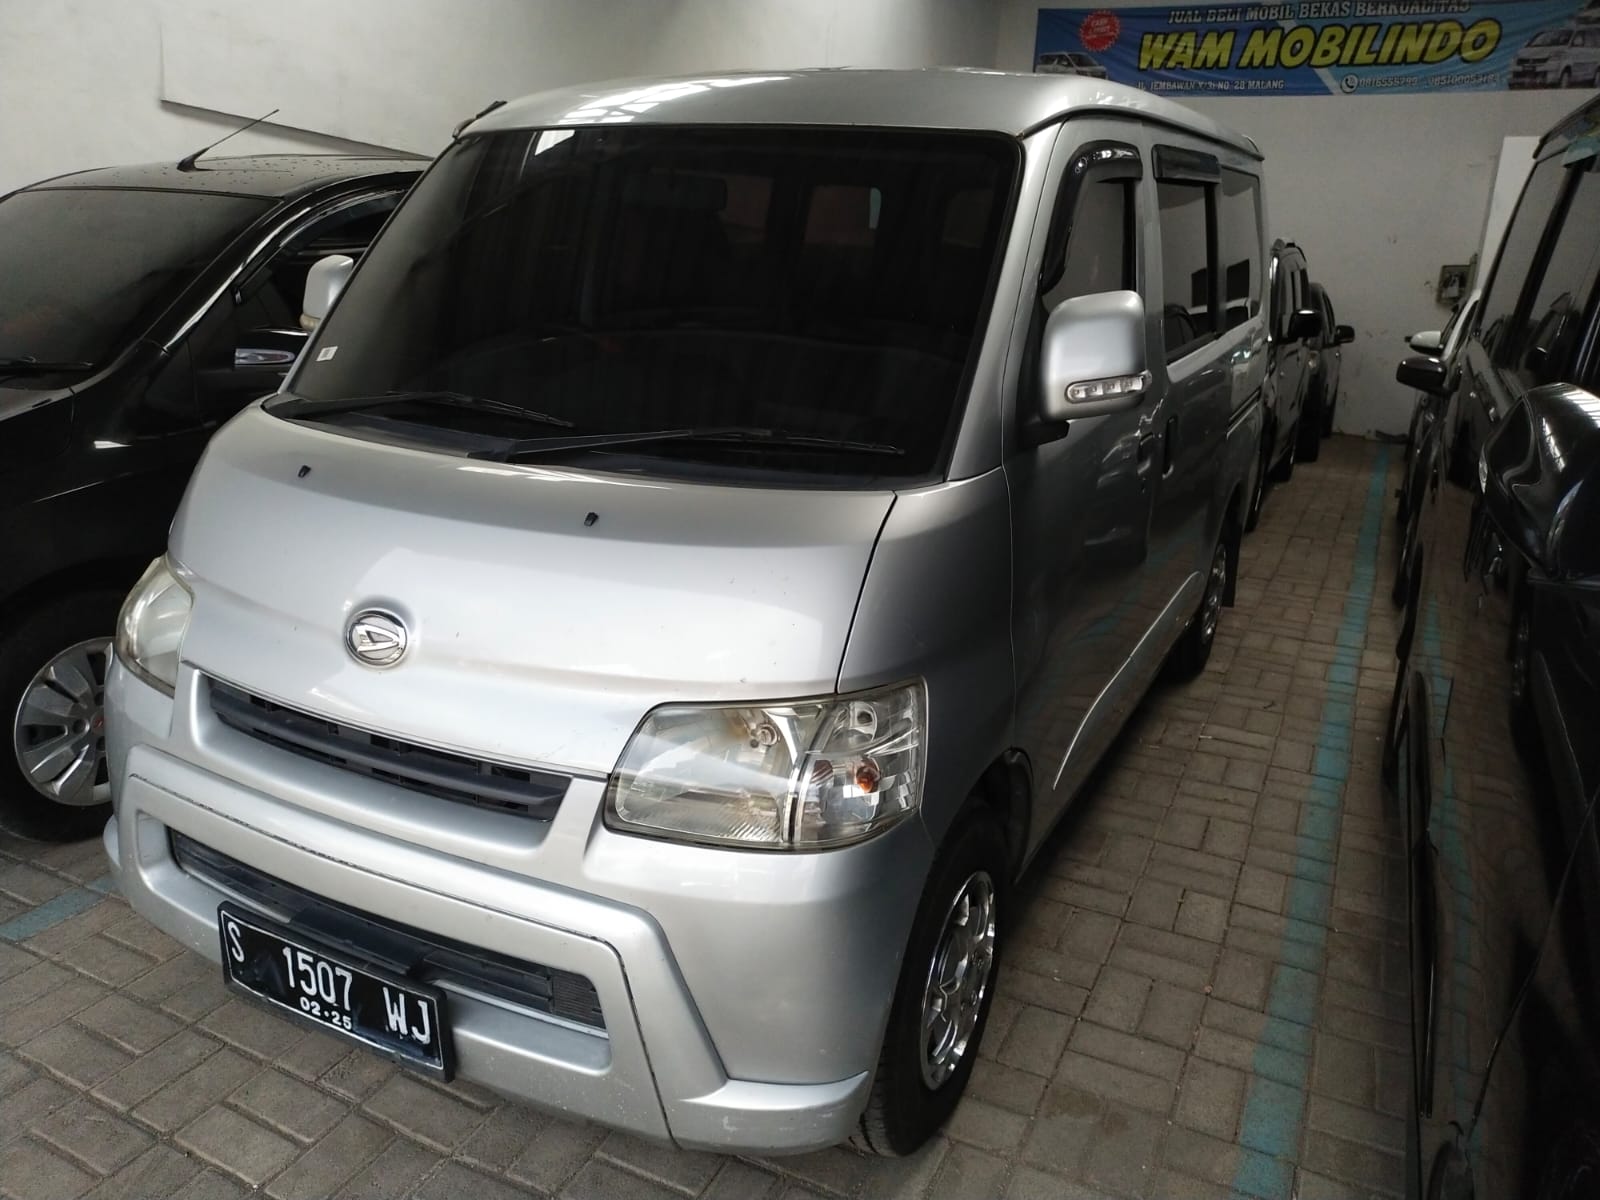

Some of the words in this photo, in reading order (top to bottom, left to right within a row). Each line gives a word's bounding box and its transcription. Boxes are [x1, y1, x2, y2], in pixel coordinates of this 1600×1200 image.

[1168, 11, 1201, 25] JUAL
[1206, 9, 1241, 22] BELI
[1245, 5, 1294, 21] MOBIL
[1299, 2, 1350, 18] BEKAS
[1138, 29, 1235, 72] WAM
[1237, 19, 1502, 70] MOBILINDO
[1247, 80, 1285, 90] MALANG
[227, 921, 246, 963] S
[282, 946, 353, 1012] 1507
[382, 986, 431, 1045] WJ
